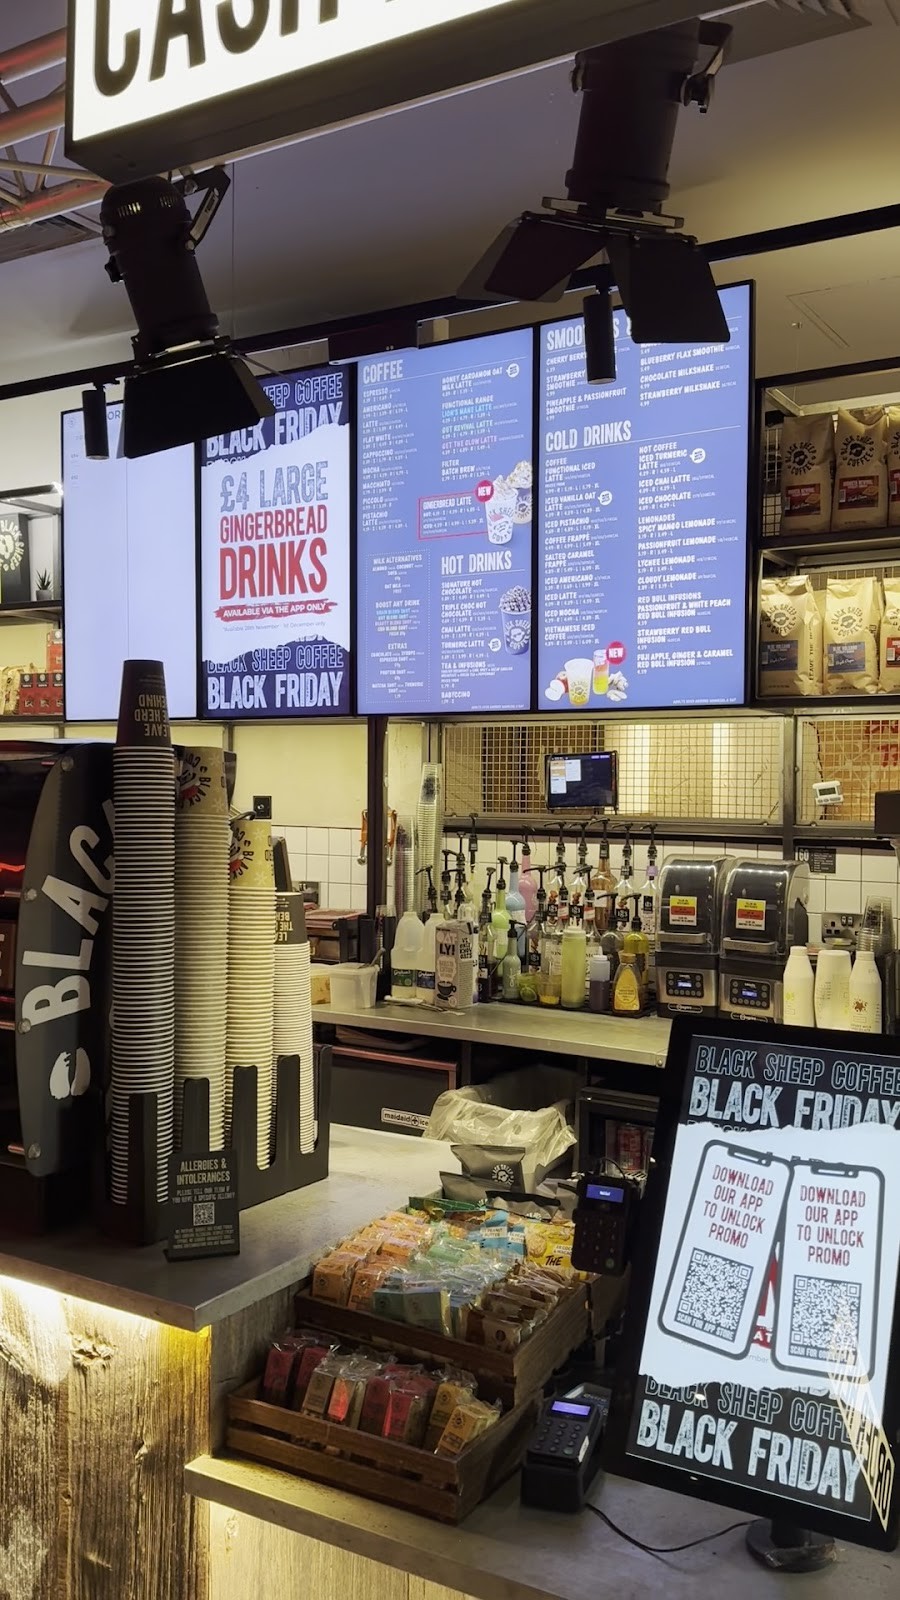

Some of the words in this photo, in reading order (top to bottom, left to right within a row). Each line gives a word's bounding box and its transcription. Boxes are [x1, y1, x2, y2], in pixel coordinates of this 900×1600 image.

[94, 0, 340, 97] CA
[640, 352, 675, 366] BLUEBERRY
[676, 349, 691, 359] FLAX
[693, 345, 724, 357] SMOOTHIE
[363, 360, 403, 384] COFFEE
[546, 371, 585, 383] STRAWBERRY
[640, 371, 676, 383] CHOCOLATE
[678, 364, 714, 376] MILKSHAKE
[263, 383, 290, 409] EEP
[295, 372, 343, 405] COFFEE
[546, 380, 575, 391] SMOOTHIE
[640, 387, 683, 401] STRAWBERRY
[684, 381, 720, 393] MILKSHAKE
[363, 387, 388, 398] ESPRESSO
[363, 403, 391, 413] AMERICANO
[546, 404, 575, 415] SMOOTHIE
[206, 417, 266, 458] BLACK
[275, 401, 343, 445] FRIDAY
[363, 420, 378, 429] LATTE
[545, 428, 577, 452] COLD
[584, 420, 631, 446] DRINKS
[363, 449, 393, 459] CAPPUCCINO
[639, 455, 653, 463] ICED
[655, 450, 687, 461] TURMERIC
[545, 457, 567, 467] COFFEE
[545, 465, 580, 475] FUNCTIONAL
[581, 462, 595, 471] ICED
[639, 462, 658, 470] LATTE
[363, 480, 391, 490] MACCHIATO
[545, 474, 563, 483] LATTE
[639, 479, 653, 487] ICED
[655, 477, 670, 486] CHAI
[671, 474, 690, 484] LATTE
[219, 472, 250, 513] £4
[259, 460, 329, 509] LARGE
[478, 486, 491, 496] NEW
[545, 496, 559, 504] ICED
[560, 494, 583, 503] VANILLA
[584, 492, 596, 500] OAT
[639, 496, 653, 505] ICED
[655, 492, 691, 503] CHOCOLATE
[363, 511, 388, 520] PISTACHIO
[638, 514, 675, 525] LEMONADES
[219, 503, 328, 544] GINGERBREAD
[545, 520, 558, 528] ICED
[560, 517, 589, 527] PISTACHIO
[638, 524, 656, 533] SPICY
[658, 522, 680, 531] MANGO
[681, 518, 715, 529] LEMONADE
[638, 540, 681, 550] PASSIONFRUIT
[683, 536, 716, 546] LEMONADE
[441, 555, 464, 575] HOT
[469, 550, 512, 573] DRINKS
[545, 553, 566, 562] SALTED
[567, 550, 594, 559] CARAMEL
[638, 558, 660, 567] LYCHEE
[662, 555, 695, 565] LEMONADE
[219, 536, 328, 601] DRINKS
[559, 574, 593, 584] AMERICANO
[638, 575, 660, 584] CLOUDY
[662, 573, 696, 582] LEMONADE
[441, 588, 472, 596] CHOCOLATE
[652, 595, 667, 603] BULL
[668, 592, 701, 602] INFUSIONS
[223, 607, 260, 618] AVAILABLE
[307, 603, 326, 611] ONLY
[441, 610, 472, 618] CHOCOLATE
[638, 612, 649, 620] RED
[652, 611, 667, 619] BULL
[668, 609, 696, 618] INFUSION
[545, 625, 581, 633] VIETNAMESE
[638, 627, 680, 637] STRAWBERRY
[681, 626, 694, 634] RED
[696, 625, 711, 633] BULL
[637, 636, 666, 644] INFUSION
[251, 646, 291, 671] SHEEP
[296, 644, 343, 668] COFFEE
[609, 648, 623, 658] NEW
[651, 660, 667, 668] BULL
[668, 659, 695, 667] INFUSION
[207, 673, 267, 710] BLACK
[275, 670, 343, 708] FRIDAY
[139, 694, 166, 708] EHIND
[144, 723, 168, 737] EAVE
[22, 799, 115, 1027] BLAC
[440, 943, 455, 956] LY!
[695, 1045, 758, 1079] BLACK
[763, 1052, 825, 1087] SHEEP
[831, 1060, 900, 1097] COFFEE
[688, 1075, 783, 1128] BLACK
[793, 1088, 900, 1131] FRIDAY
[180, 1159, 218, 1172] ALLERGIES
[221, 1158, 227, 1169] &
[177, 1171, 230, 1185] INTOLERANCES
[712, 1165, 774, 1196] DOWNLOAD
[714, 1185, 736, 1205] OUR
[740, 1193, 763, 1212] APP
[800, 1185, 866, 1207] DOWNLOAD
[703, 1200, 718, 1218] TO
[721, 1207, 766, 1234] UNLOCK
[805, 1205, 828, 1223] OUR
[834, 1209, 858, 1226] APP
[708, 1223, 749, 1248] PROMO
[797, 1224, 812, 1241] TO
[817, 1226, 864, 1248] UNLOCK
[545, 1255, 563, 1266] THE
[808, 1246, 850, 1266] PROMO
[676, 1313, 692, 1321] SCAN
[691, 1319, 704, 1328] FOR
[703, 1322, 715, 1332] APP
[716, 1328, 734, 1340] STORE
[789, 1345, 805, 1356] SCAN
[806, 1347, 818, 1358] FOR
[717, 1381, 783, 1424] SHEEP
[636, 1398, 738, 1471] BLACK
[747, 1426, 864, 1503] FRIDAY
